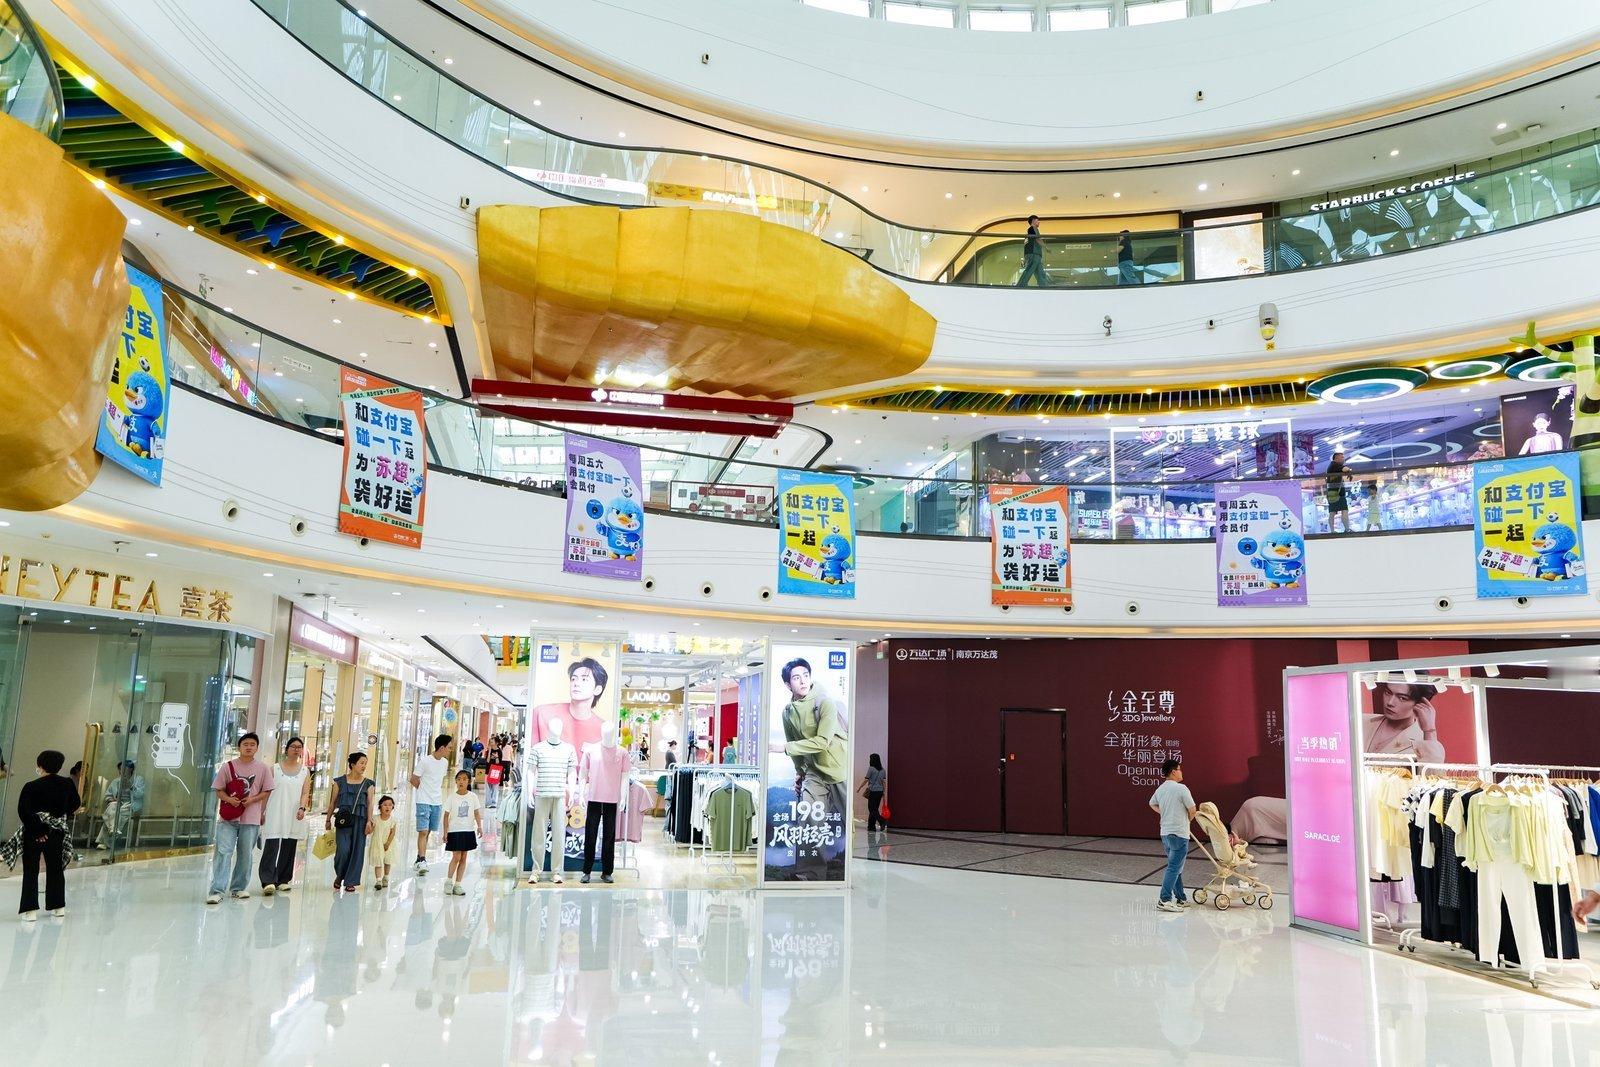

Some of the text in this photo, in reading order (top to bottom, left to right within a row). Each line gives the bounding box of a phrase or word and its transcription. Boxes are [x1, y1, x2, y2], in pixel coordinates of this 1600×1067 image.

[1310, 185, 1407, 212] STARBUCKS
[355, 402, 413, 437] 和支付宝
[355, 426, 401, 456] 碰一下
[568, 453, 604, 470] 每周五六
[569, 466, 631, 487] 用支付宝碰一下
[570, 479, 596, 494] 会员付
[1484, 480, 1567, 503] 和支付宝
[353, 477, 413, 516] 袋好运
[785, 492, 845, 513] 和支付宝
[1219, 500, 1258, 510] 每周五六
[786, 511, 830, 529] 碰一下
[1002, 507, 1057, 522] 和支付宝
[1219, 509, 1289, 521] 用支付宝碰一下
[1484, 502, 1545, 523] 碰一下
[1002, 525, 1046, 540] 碰一下
[1219, 523, 1249, 533] 会员付
[1484, 523, 1525, 542] 一起
[787, 529, 816, 547] 一起
[1003, 562, 1060, 582] 袋好运
[180, 585, 233, 623] 喜茶
[831, 654, 844, 663] HLA
[909, 648, 998, 659] 万达广场 南京万达茂
[626, 691, 671, 702] LAOMIAO
[1121, 690, 1176, 714] 金至尊
[1121, 713, 1176, 724] 3DG Jewellery
[1104, 731, 1162, 748] 全新形象
[1122, 748, 1183, 764] 华丽登场
[1131, 775, 1160, 786] Soon
[787, 849, 818, 857] 皮肤衣
